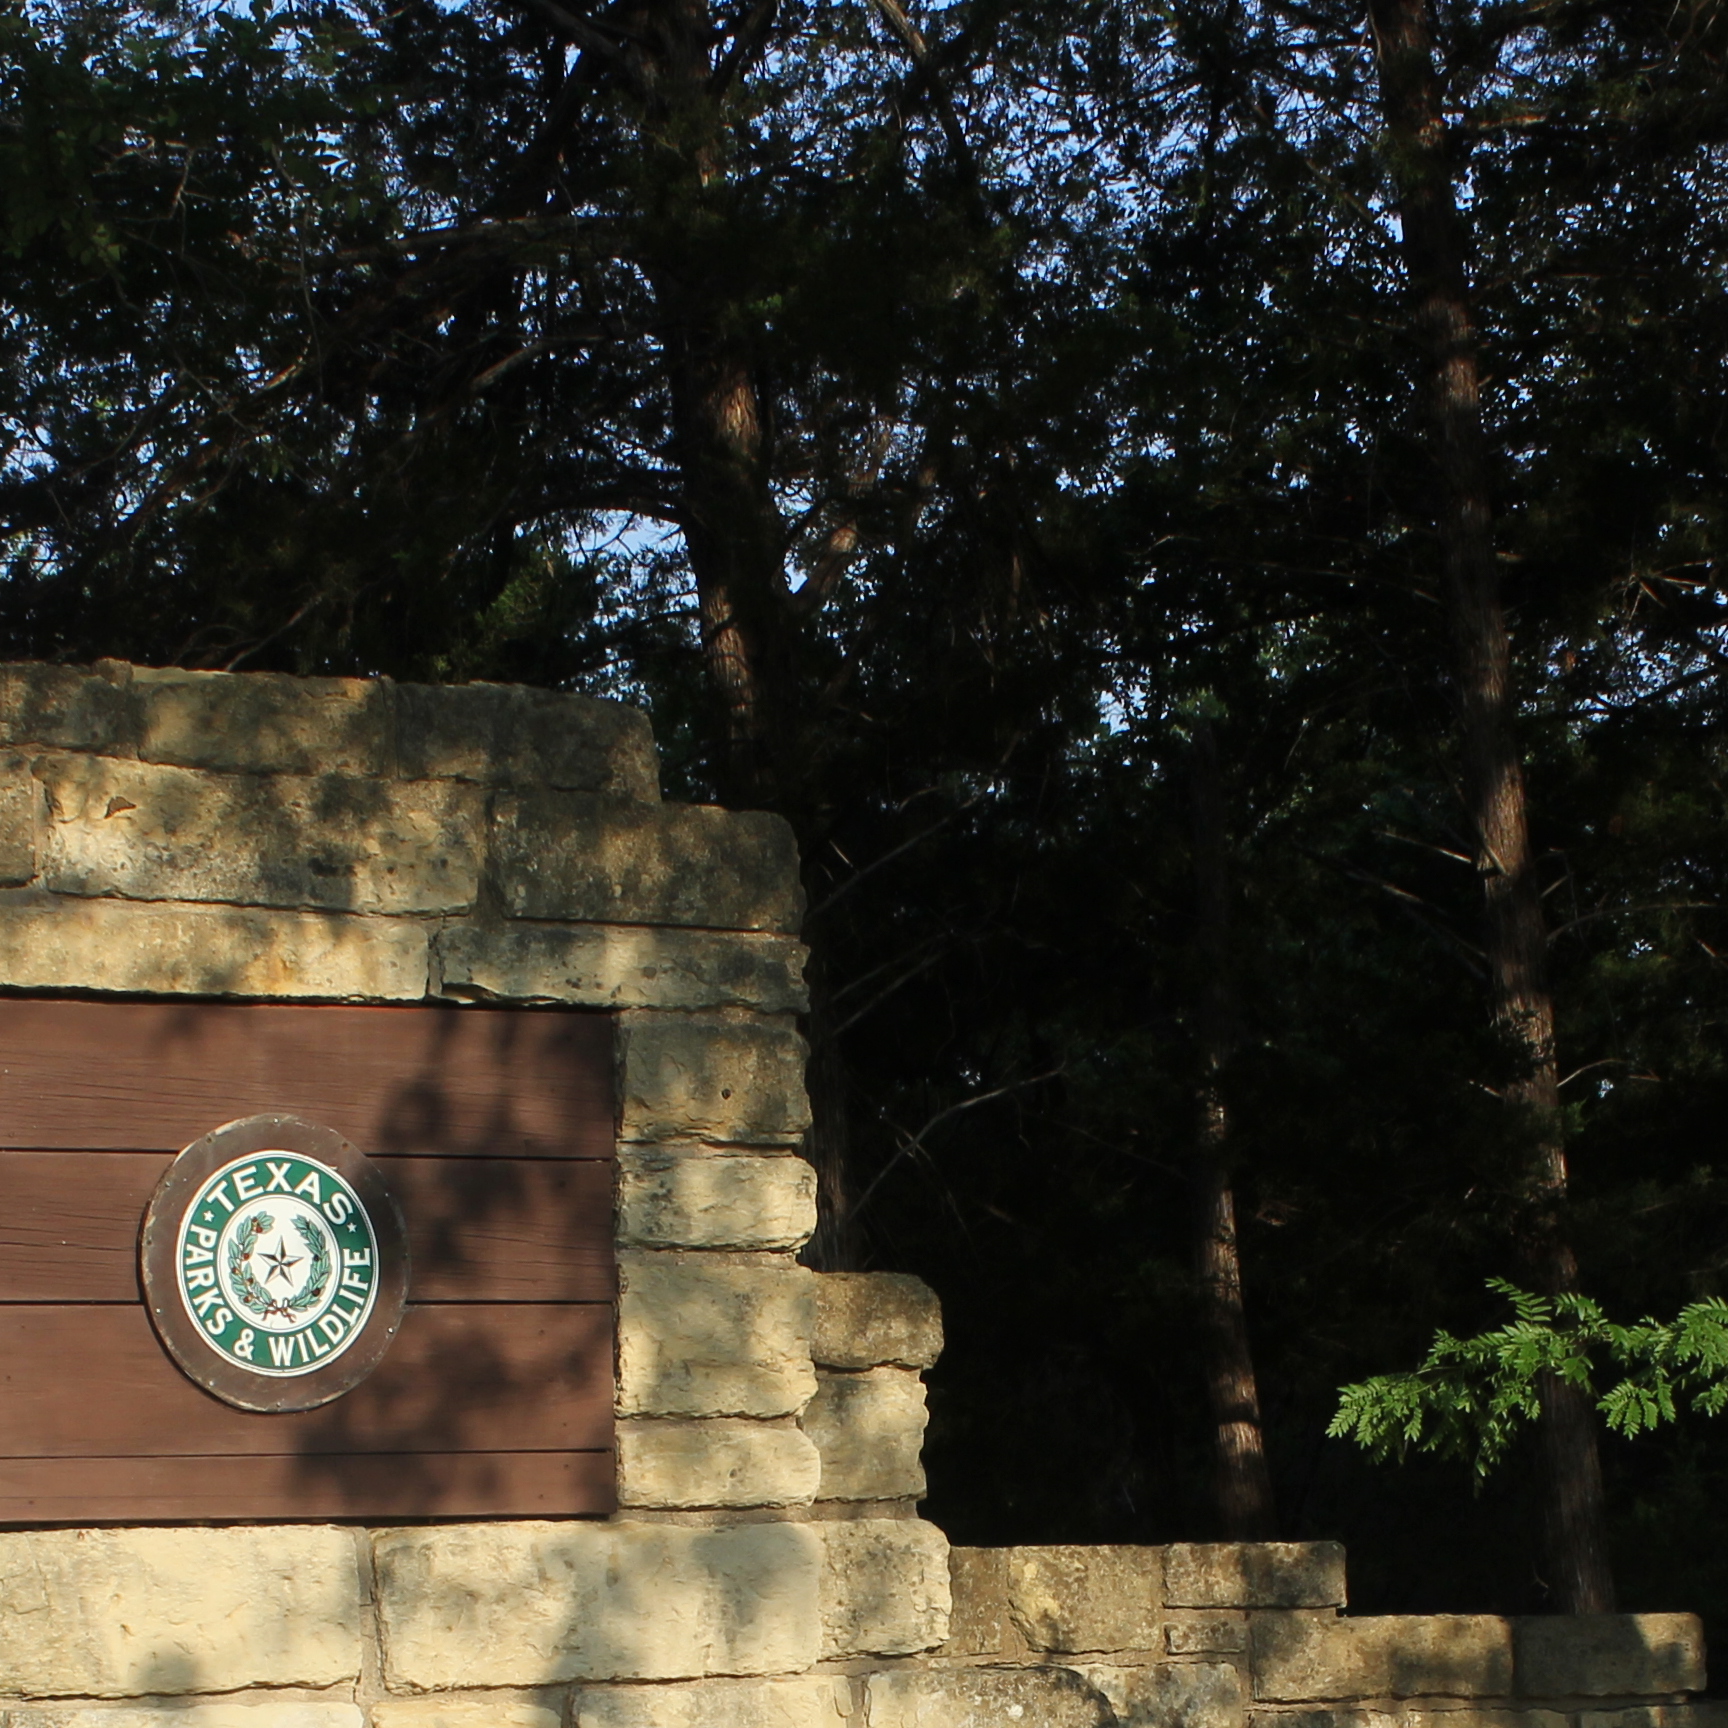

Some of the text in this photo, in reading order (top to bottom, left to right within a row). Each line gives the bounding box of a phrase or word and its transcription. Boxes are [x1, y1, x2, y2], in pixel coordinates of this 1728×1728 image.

[206, 1162, 354, 1226] TEXAS
[184, 1226, 371, 1367] PARKS & WILDLIFE
